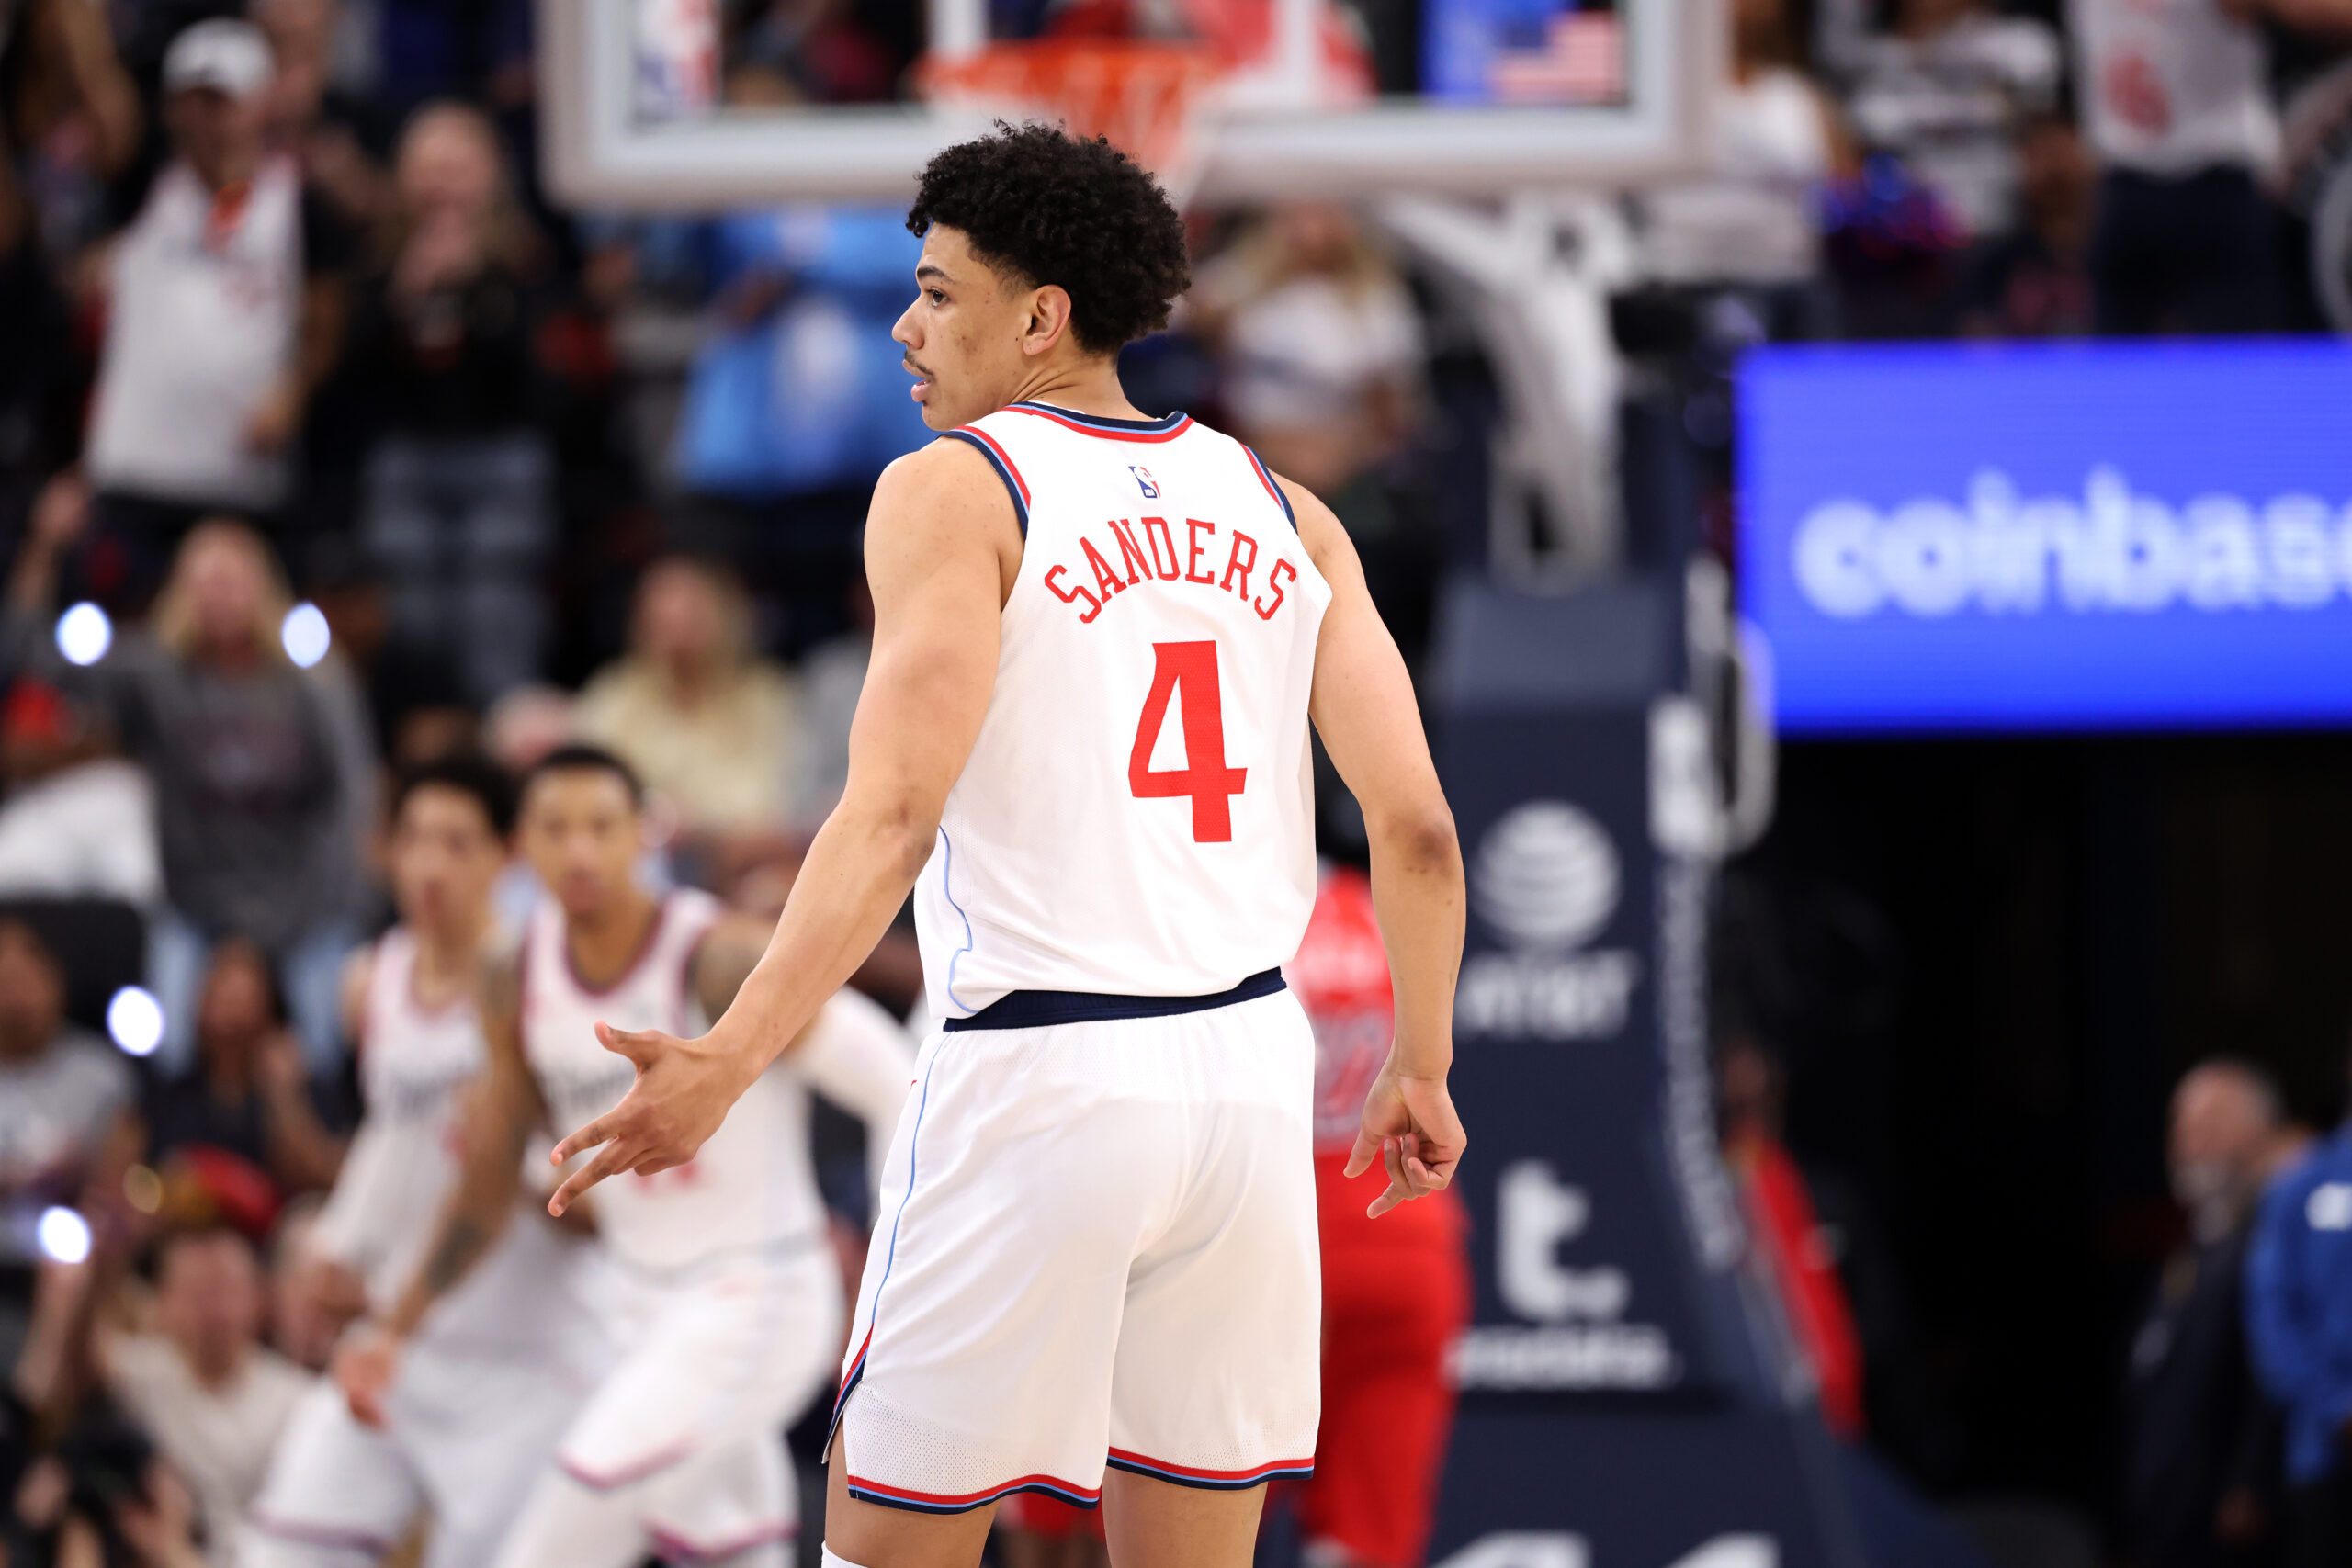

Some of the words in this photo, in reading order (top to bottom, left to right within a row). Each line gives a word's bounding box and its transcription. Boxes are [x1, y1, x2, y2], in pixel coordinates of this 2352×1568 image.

[1044, 516, 1297, 624] SANDERS
[1792, 467, 2352, 616] coinbas
[1128, 639, 1248, 842] 4
